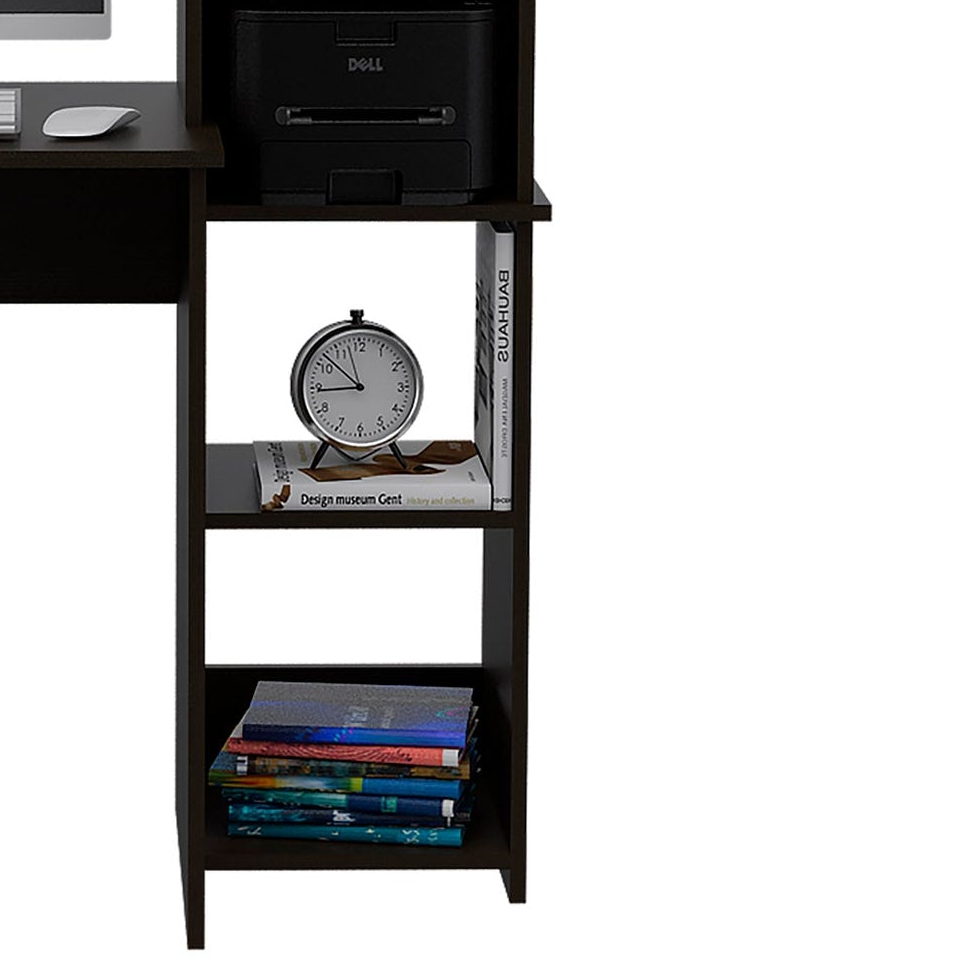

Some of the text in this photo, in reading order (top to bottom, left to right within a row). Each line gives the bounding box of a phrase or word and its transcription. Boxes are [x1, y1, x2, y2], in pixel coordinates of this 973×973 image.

[348, 58, 383, 71] DELL
[354, 342, 366, 352] 12
[336, 350, 346, 359] 11
[380, 348, 382, 357] 1
[321, 364, 332, 374] 10
[392, 361, 399, 372] 2
[315, 383, 322, 392] 9
[397, 382, 404, 392] 3
[322, 402, 328, 412] 8
[392, 404, 398, 415] 4
[339, 417, 345, 427] 7
[376, 416, 384, 426] 5
[357, 422, 363, 431] 6
[301, 494, 334, 507] Design
[336, 496, 376, 505] museum
[378, 494, 402, 505] Gent
